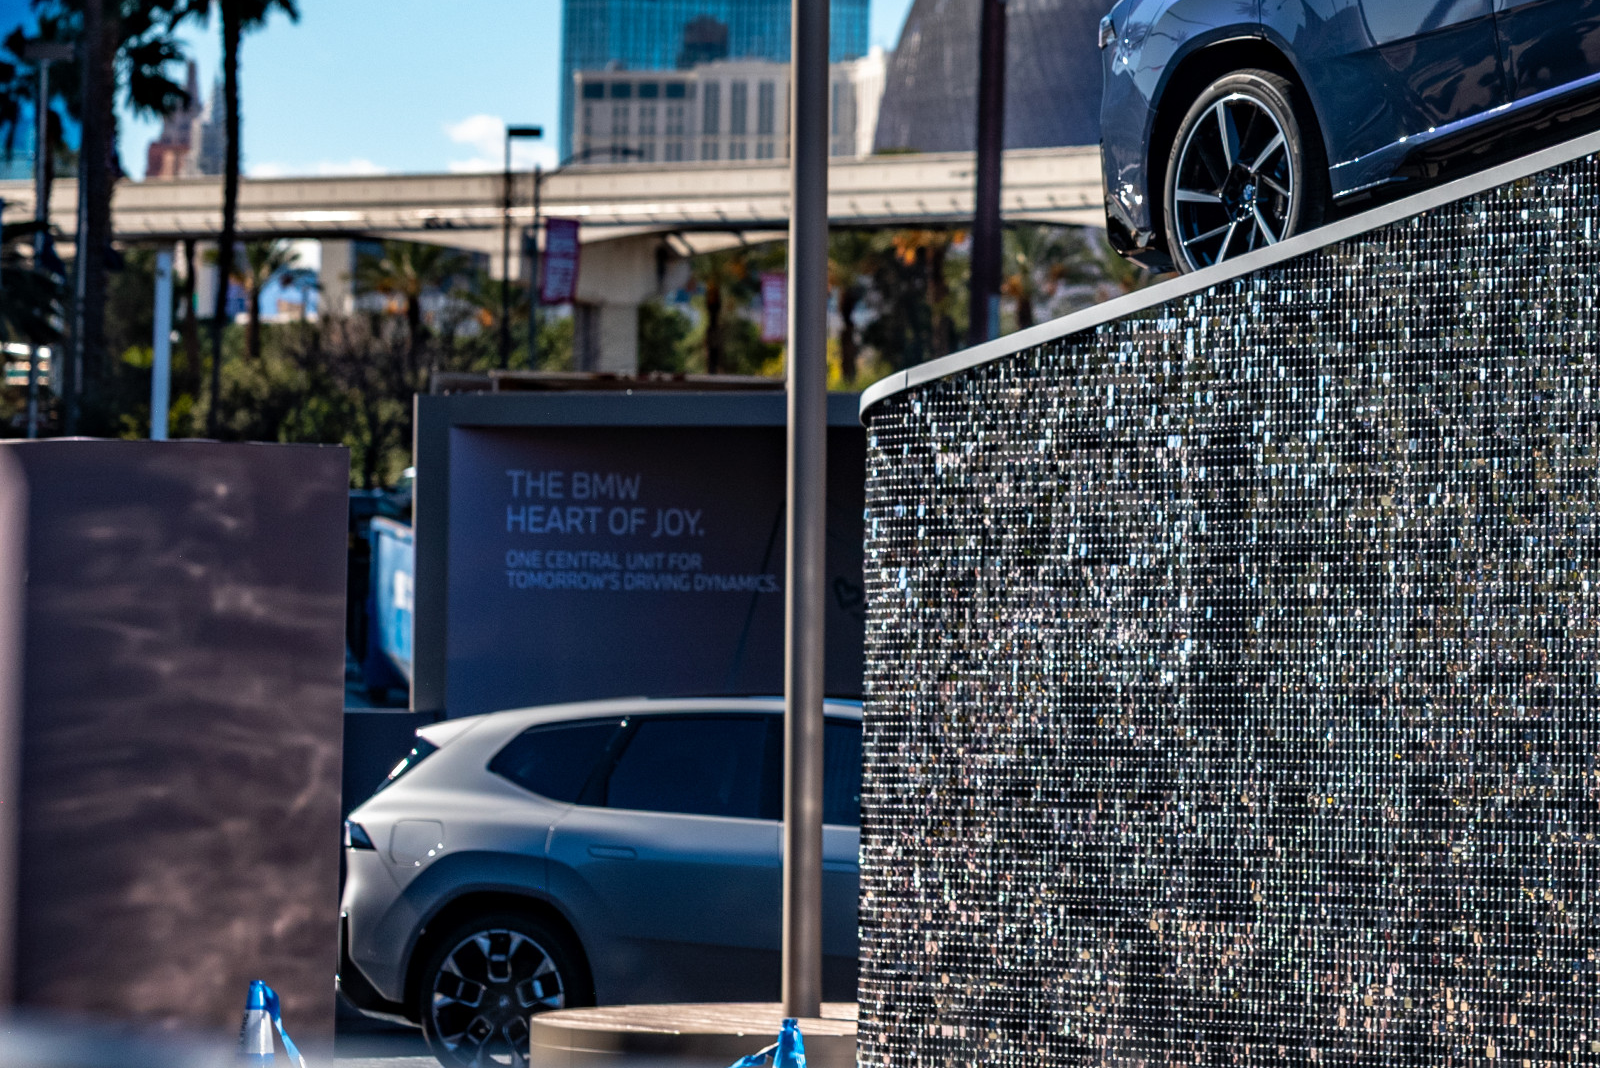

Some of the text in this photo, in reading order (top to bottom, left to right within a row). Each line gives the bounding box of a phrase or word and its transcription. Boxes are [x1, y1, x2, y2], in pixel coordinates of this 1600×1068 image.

[505, 469, 642, 501] THE BMW
[506, 505, 705, 538] HEART OF JOY.
[505, 549, 703, 572] ONE CENTRAL UNIT FOR
[505, 570, 620, 591] TOMORROW'S
[623, 572, 691, 592] DRIVING
